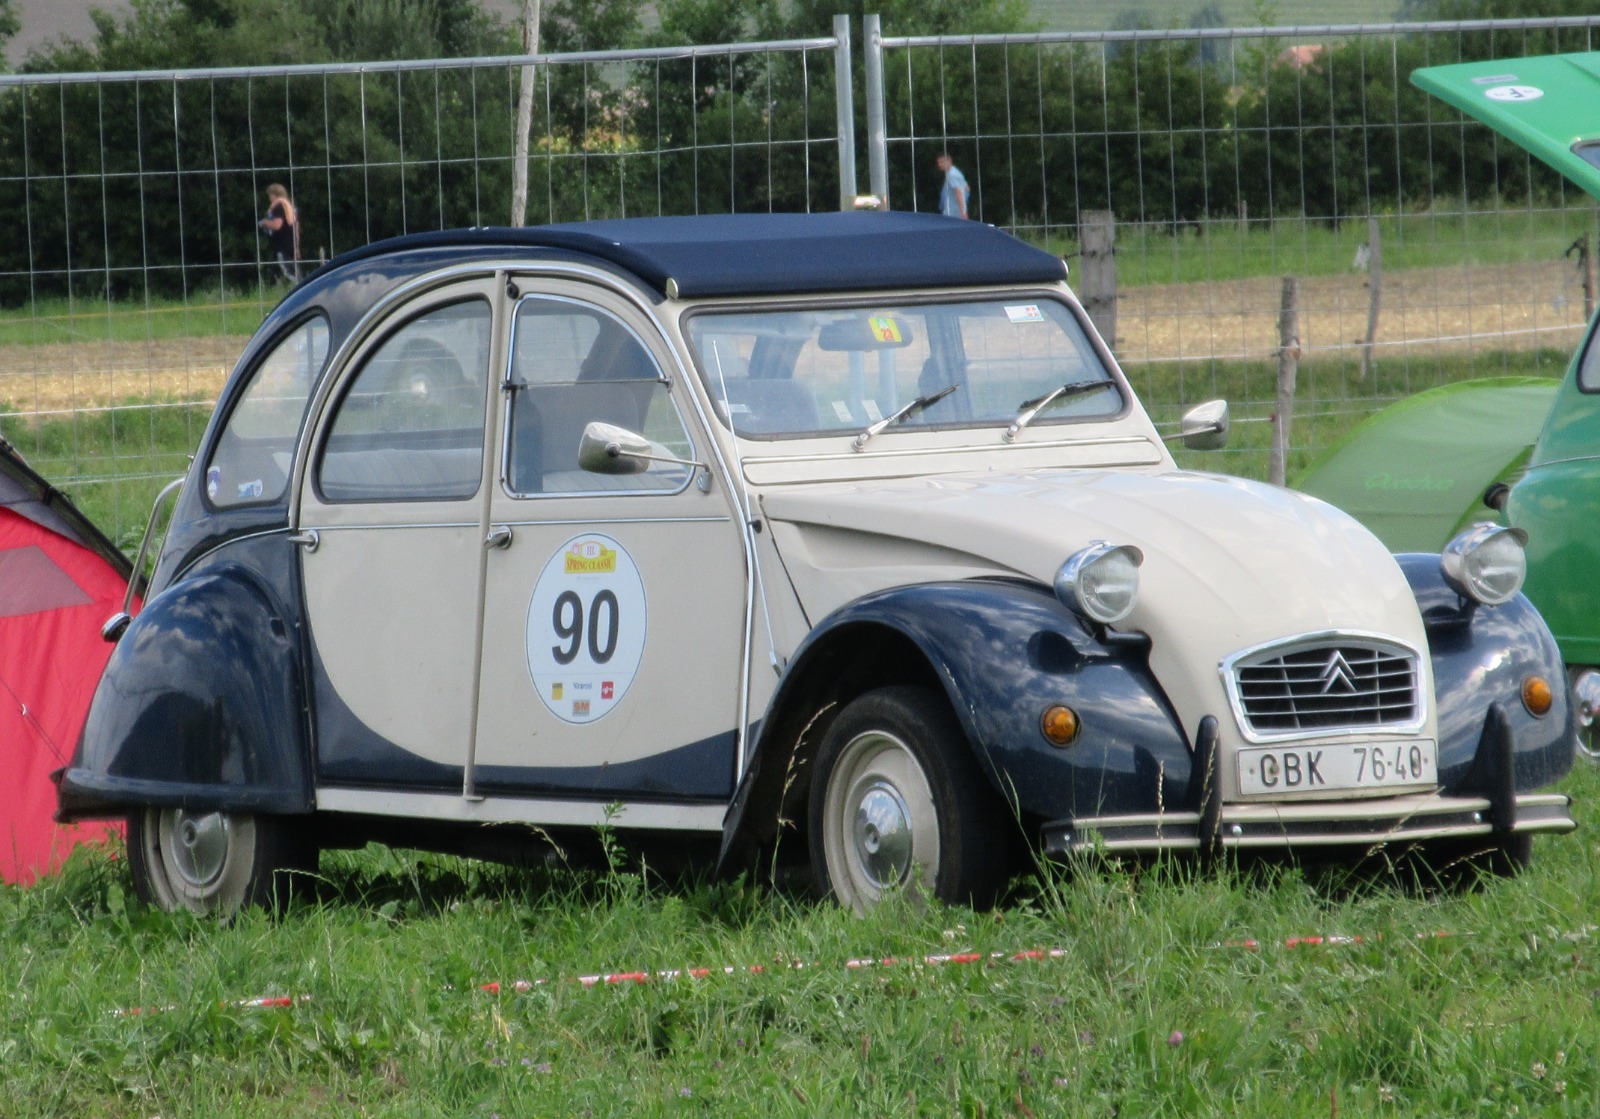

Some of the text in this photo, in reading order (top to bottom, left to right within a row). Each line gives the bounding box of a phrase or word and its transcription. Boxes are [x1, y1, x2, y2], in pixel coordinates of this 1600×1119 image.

[566, 557, 613, 571] SPRING CLASSIC
[552, 589, 620, 666] 90
[1260, 745, 1423, 788] CBK 76-40
